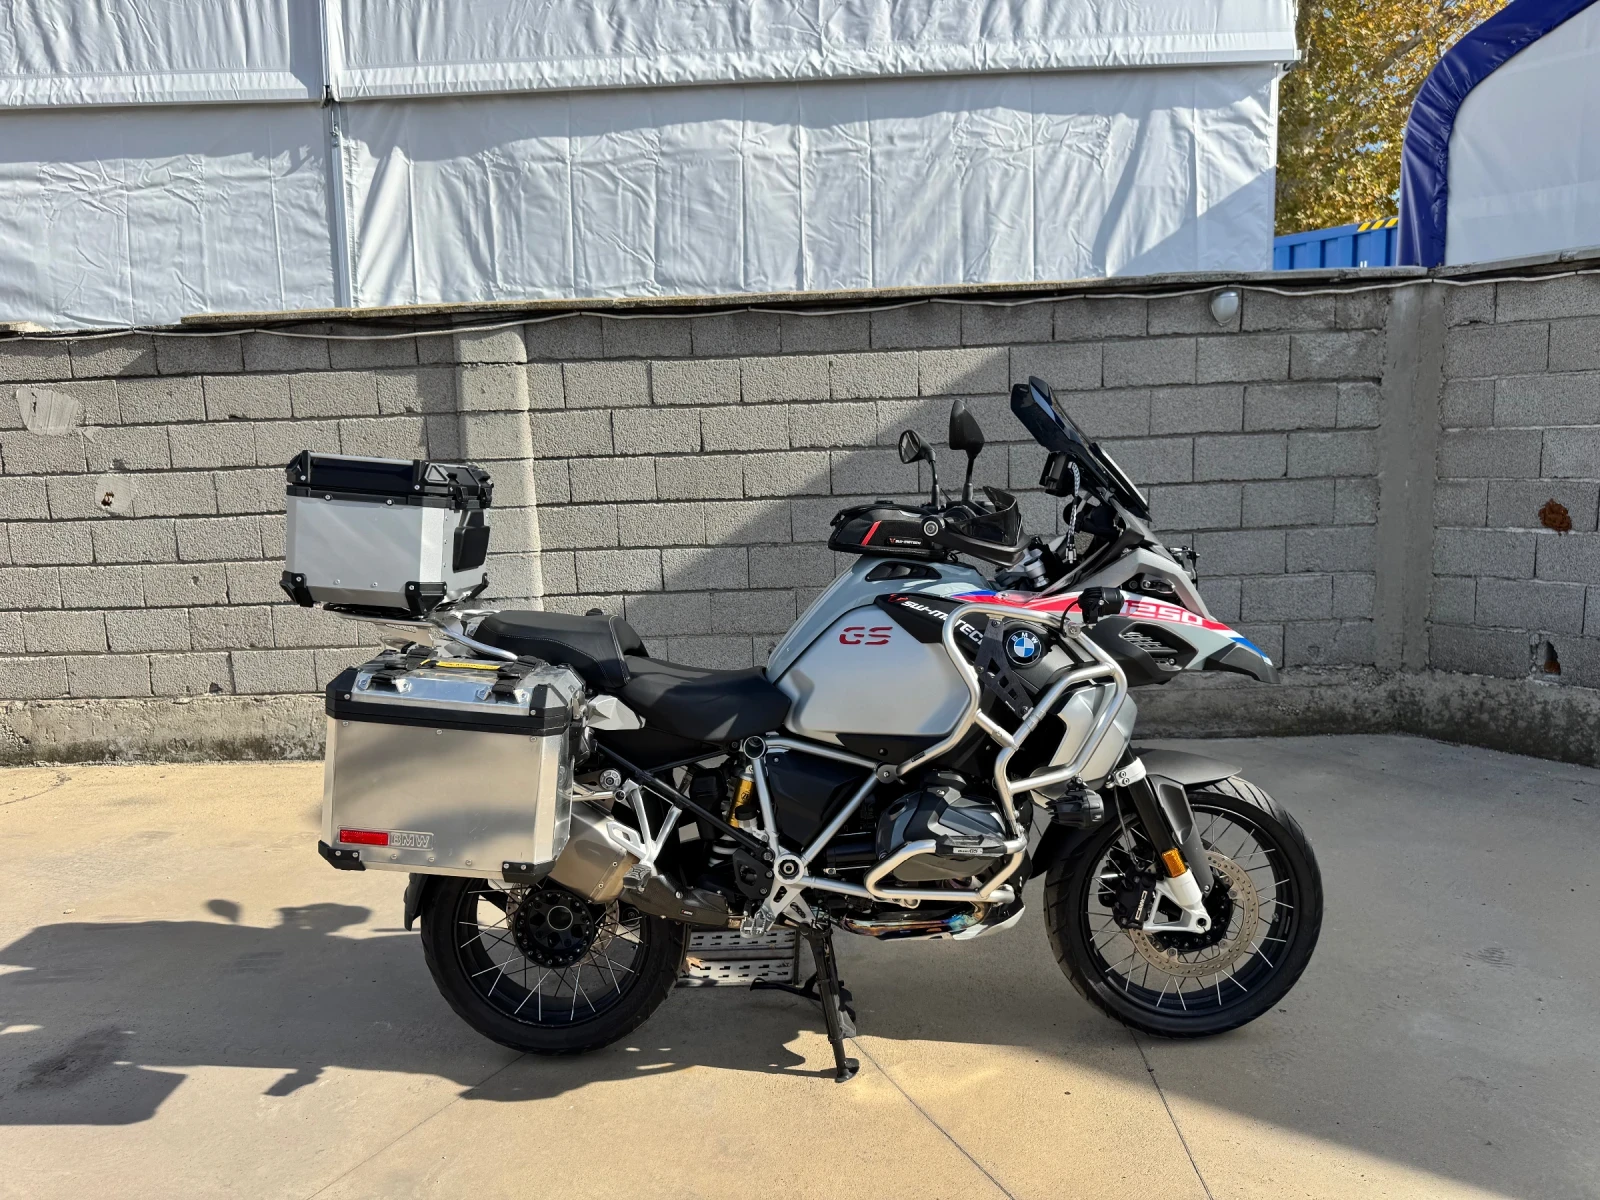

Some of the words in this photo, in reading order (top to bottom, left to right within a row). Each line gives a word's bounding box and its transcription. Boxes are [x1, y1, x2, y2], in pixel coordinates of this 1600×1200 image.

[901, 600, 984, 646] SW-MTEC
[1119, 601, 1204, 626] 1250
[839, 626, 894, 646] GS
[1010, 632, 1039, 644] BMW
[391, 832, 431, 848] BMW
